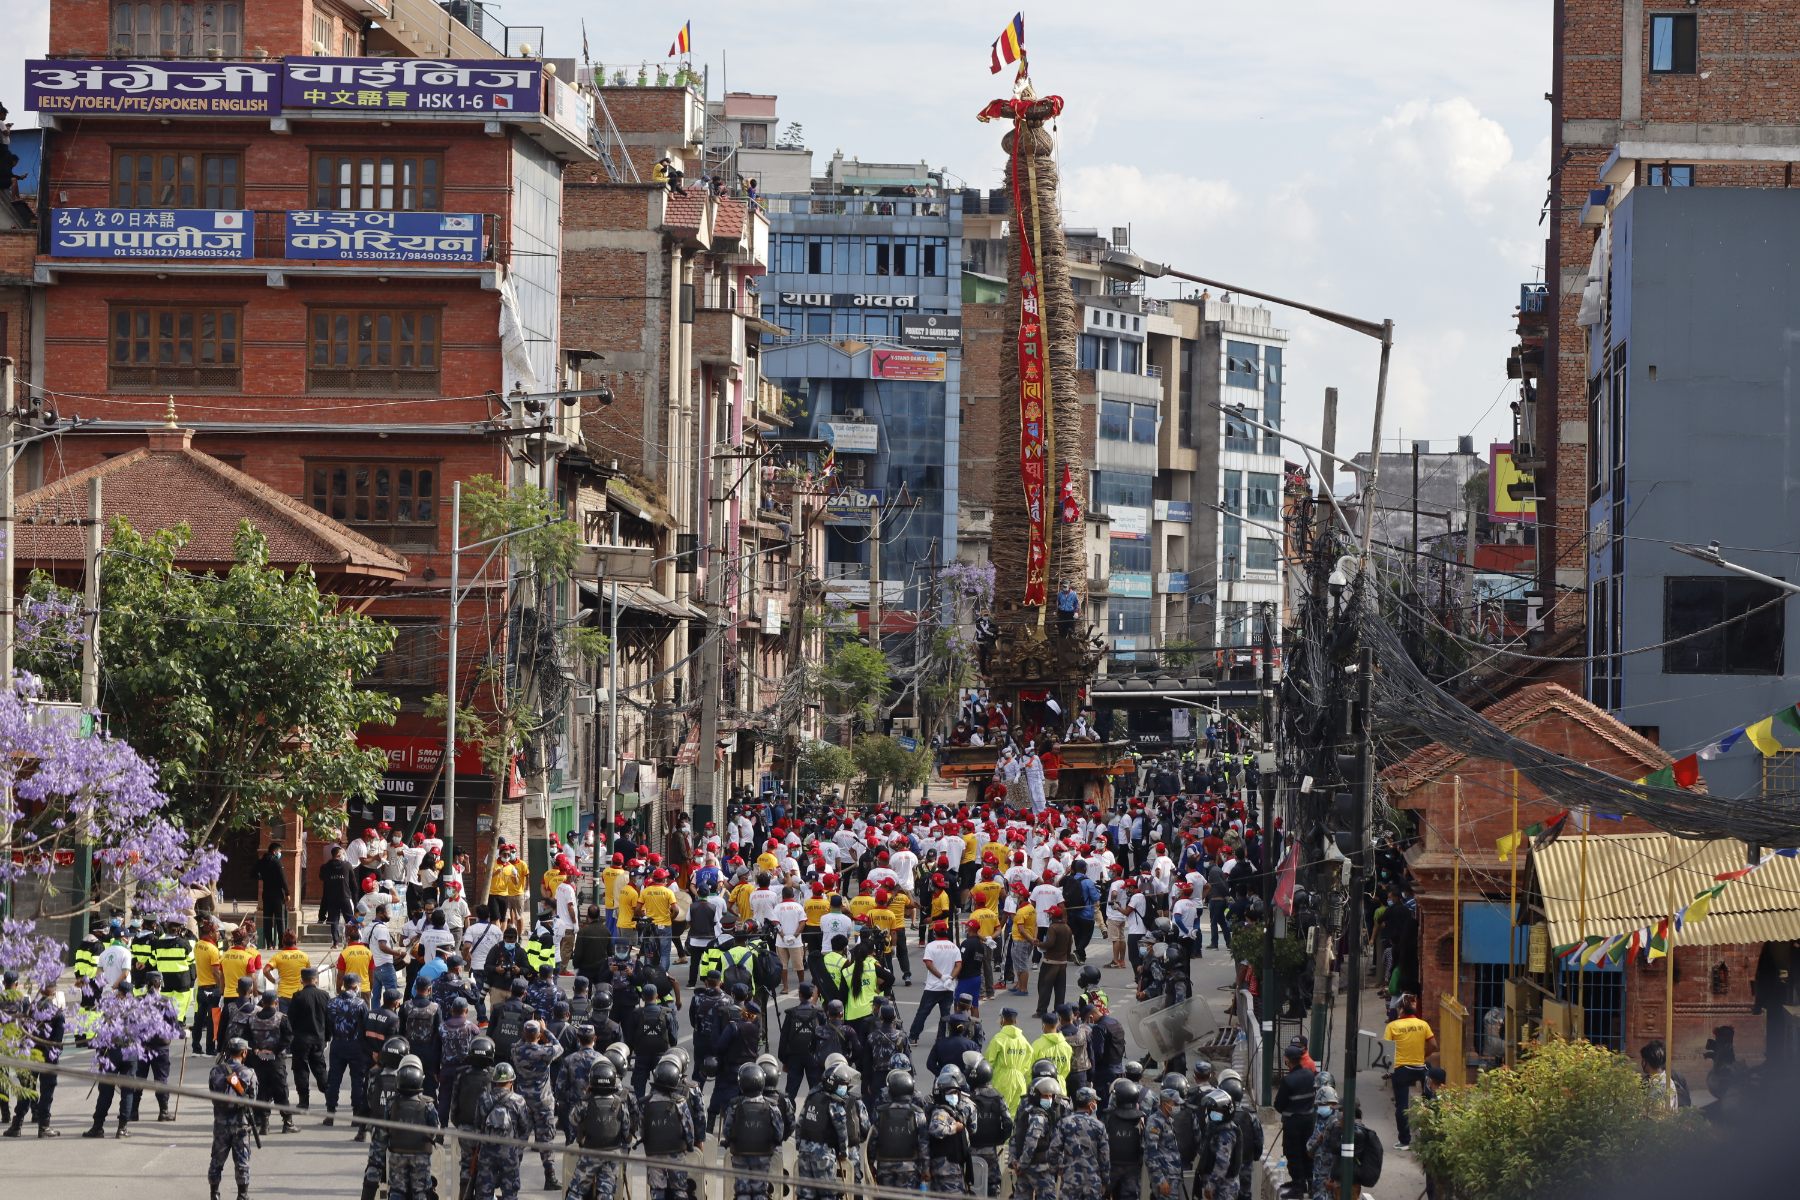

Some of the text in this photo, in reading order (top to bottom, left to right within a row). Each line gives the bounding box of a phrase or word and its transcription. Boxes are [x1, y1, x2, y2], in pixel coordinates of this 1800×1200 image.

[31, 65, 276, 93] अंग्रेजी
[288, 61, 537, 89] चाईनिज
[38, 96, 268, 111] IELTS/TOEFL/PTE/SPOKEN ENGLISH
[303, 89, 410, 107] 中文語言
[418, 93, 484, 109] HSK 1-6
[58, 211, 176, 228] みんなの日本語
[291, 212, 395, 229] 한국어
[58, 226, 246, 249] जापानीज
[291, 229, 478, 252] कोरियन
[129, 249, 242, 258] 5530121/9849035242
[340, 251, 474, 261] 01 5530121/9849035242
[854, 293, 917, 308] भवन
